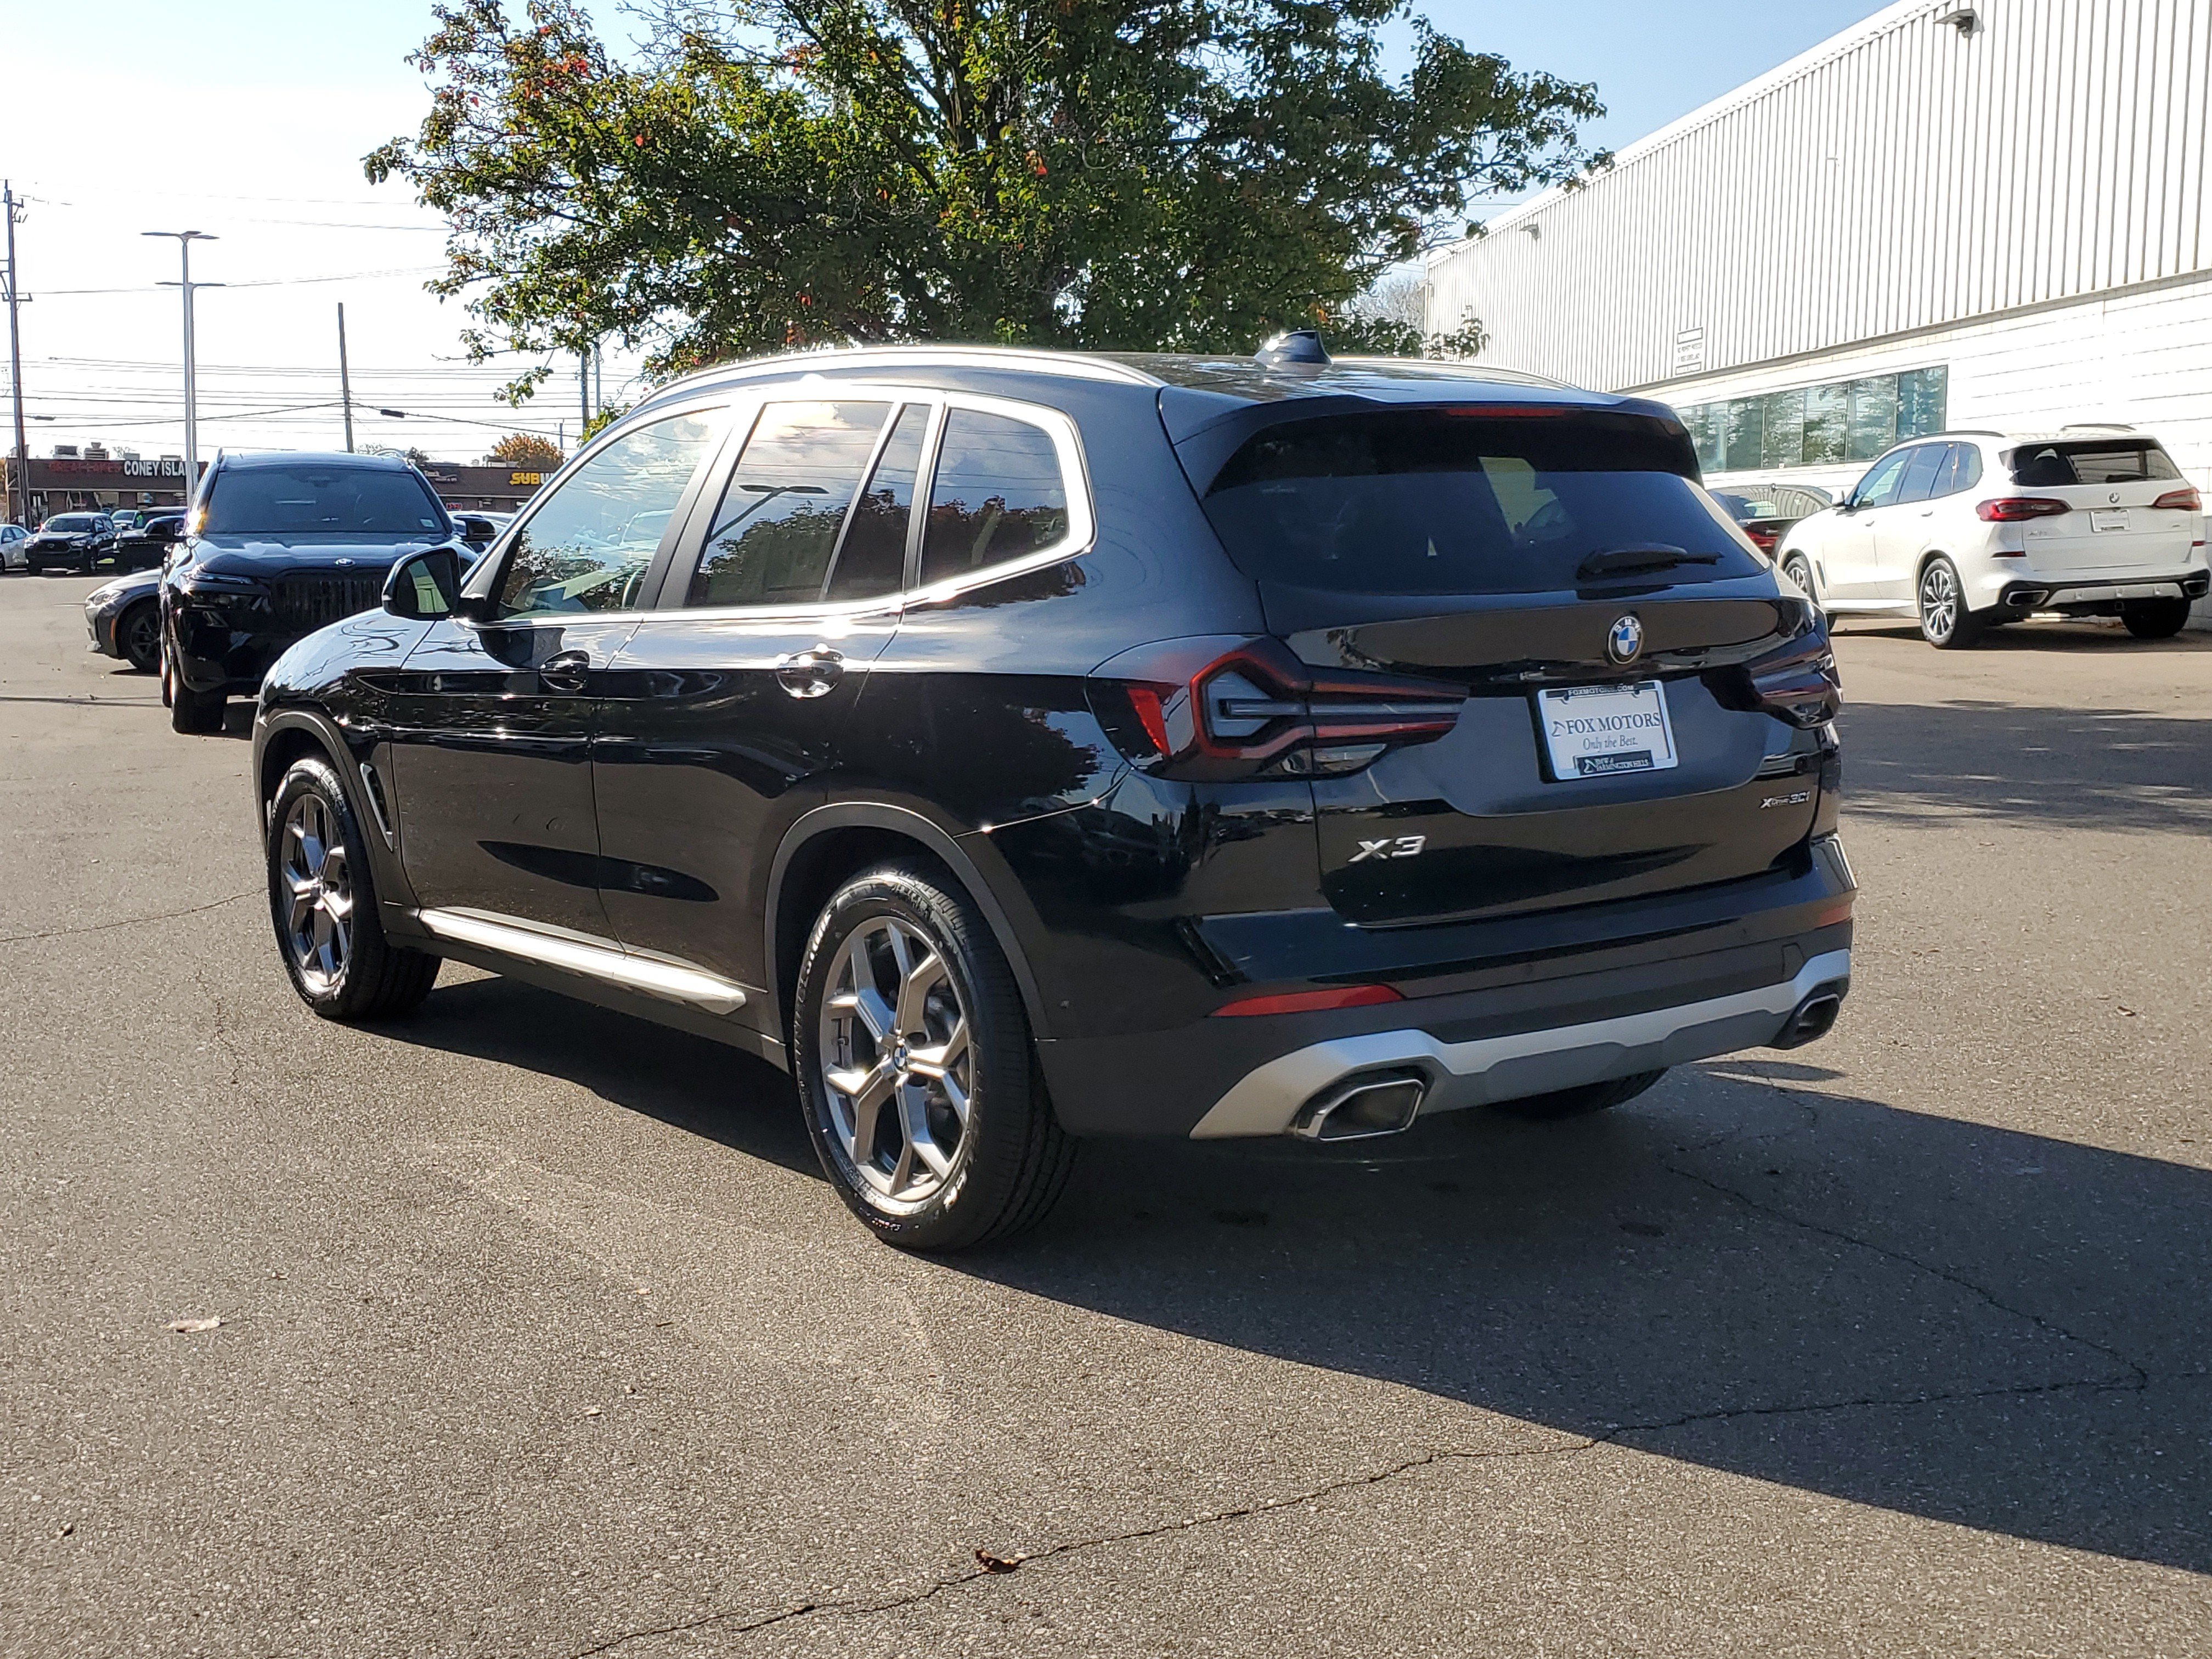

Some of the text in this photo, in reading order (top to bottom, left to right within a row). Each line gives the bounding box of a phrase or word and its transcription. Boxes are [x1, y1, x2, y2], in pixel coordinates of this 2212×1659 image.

[123, 460, 158, 476] CONEY
[162, 460, 199, 476] ISLA
[1565, 712, 1661, 735] FOX MOTORS
[1583, 734, 1639, 752] Only the Best.
[1347, 835, 1426, 862] X3
